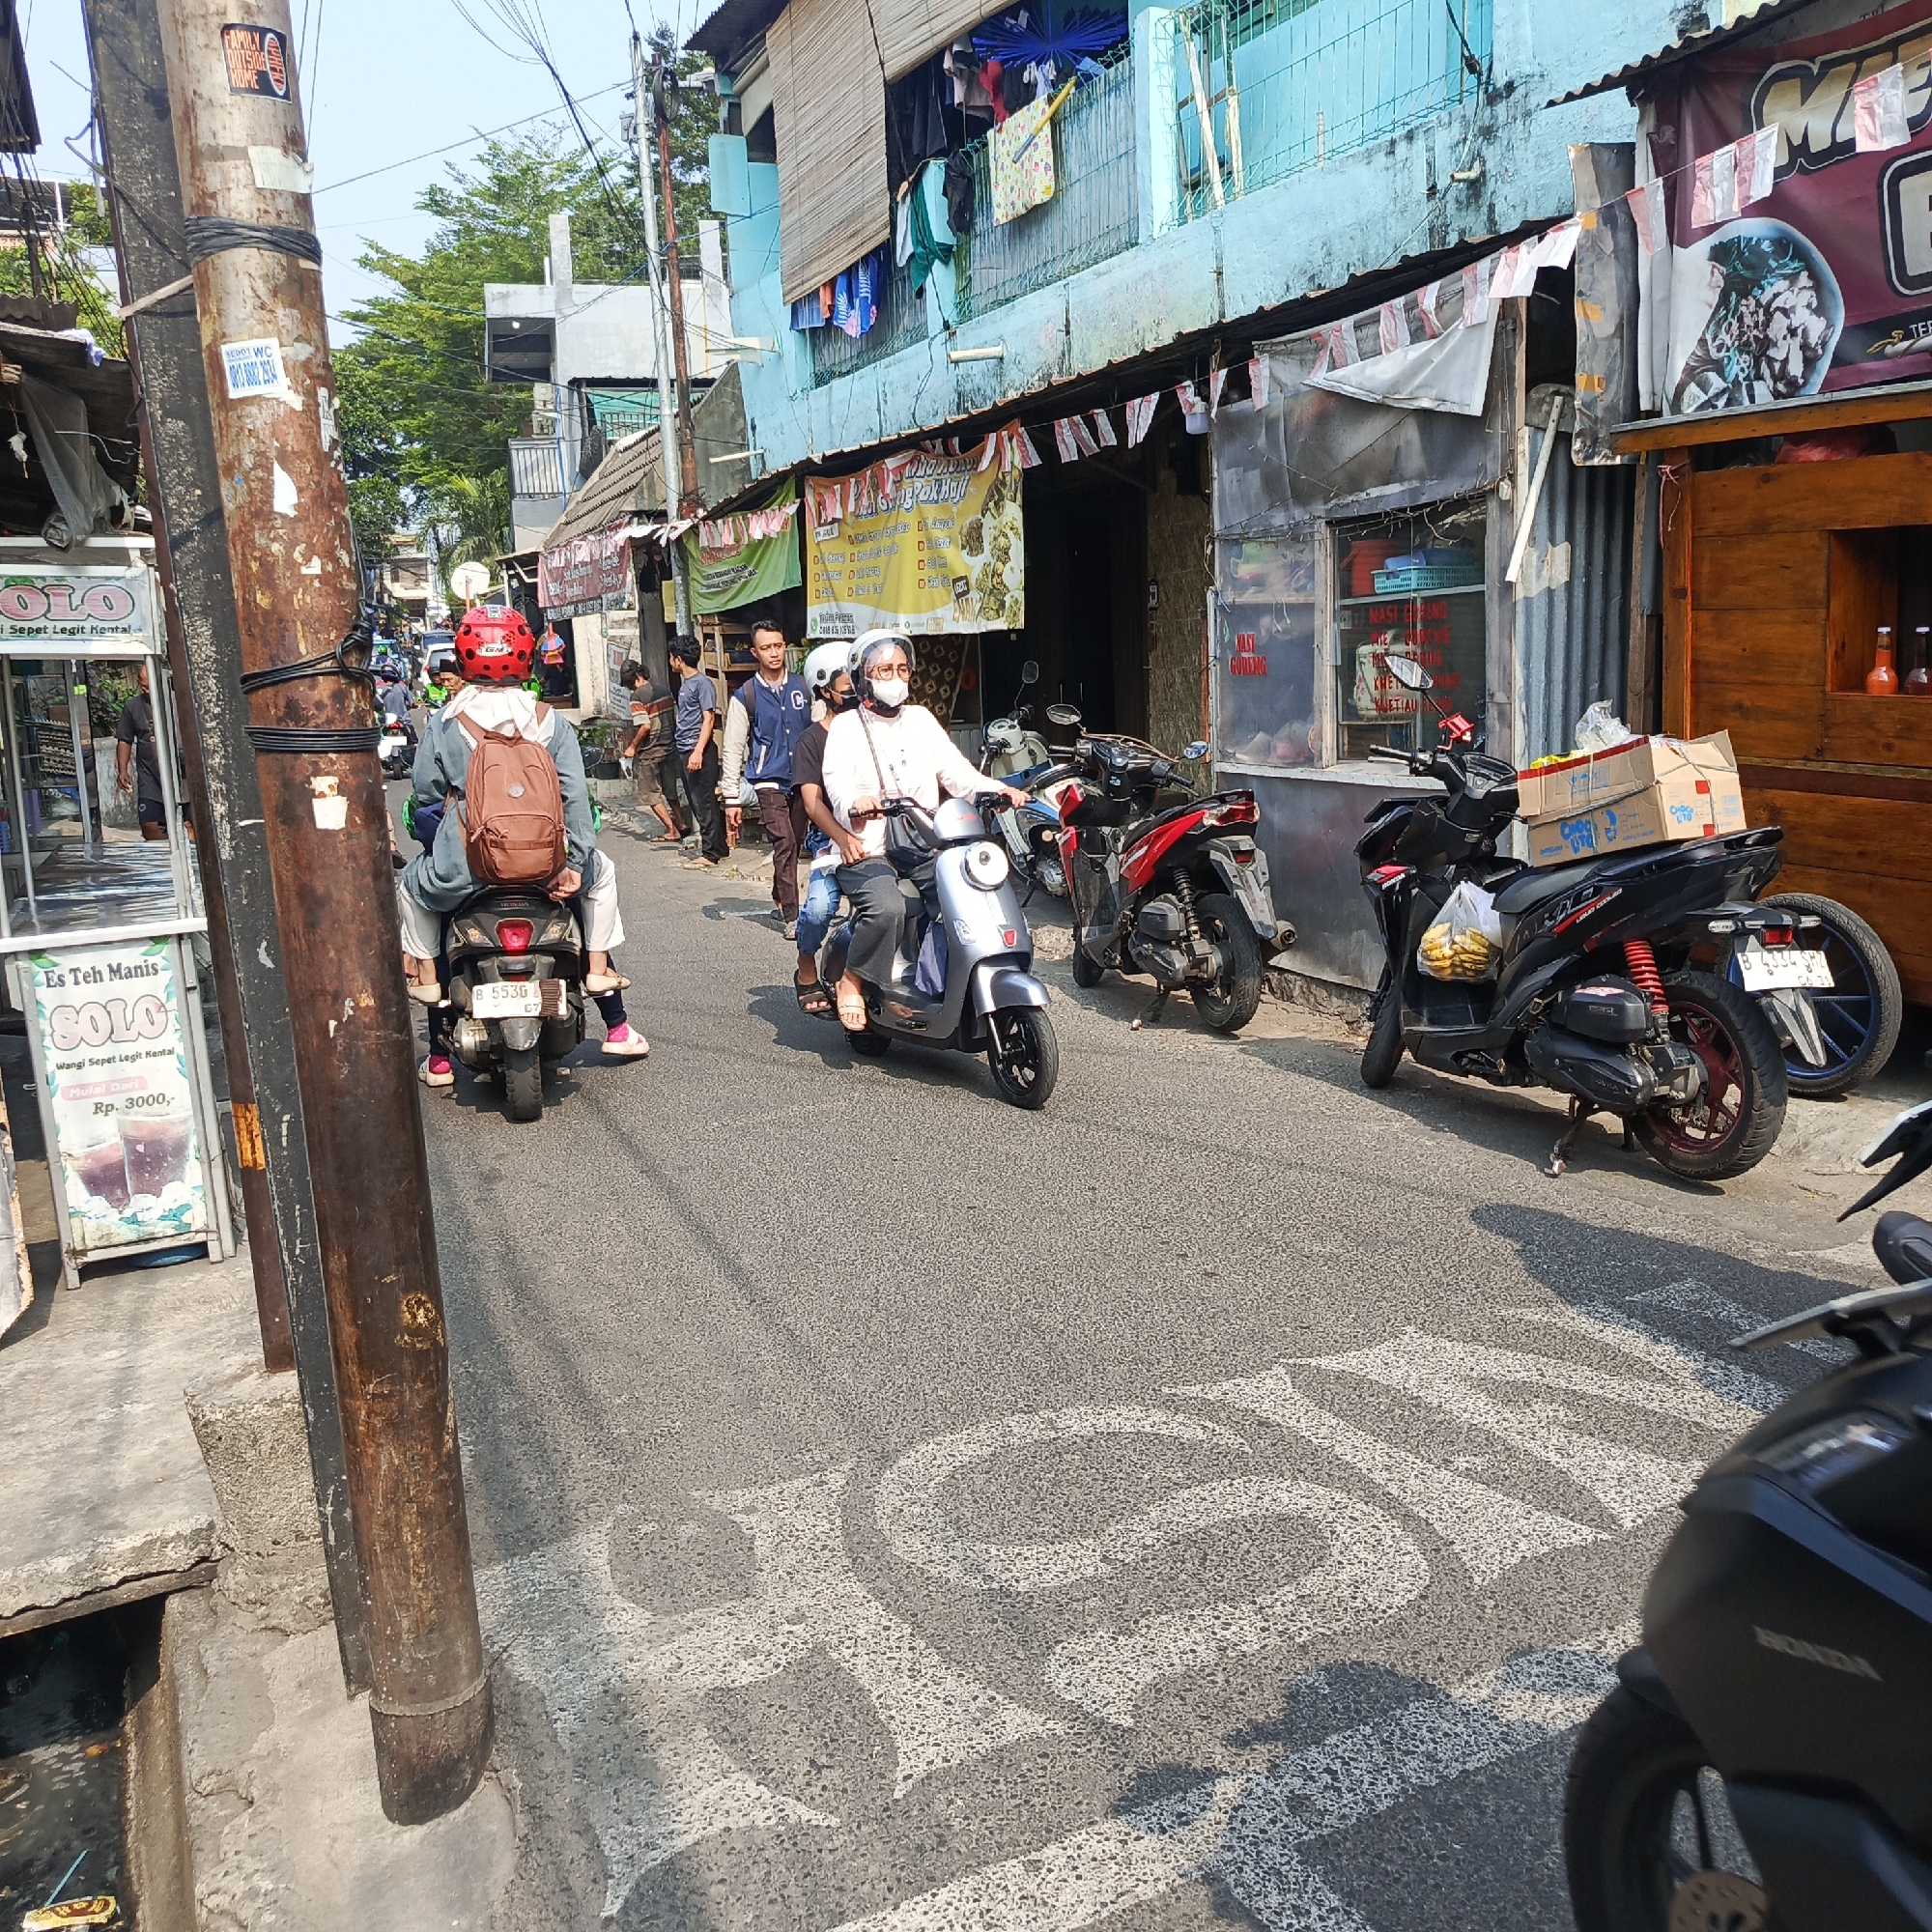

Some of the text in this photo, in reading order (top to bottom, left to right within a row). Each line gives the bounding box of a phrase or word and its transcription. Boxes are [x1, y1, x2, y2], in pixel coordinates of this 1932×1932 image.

[224, 29, 261, 51] FAMILY
[227, 49, 267, 71] OUTSIDE
[229, 69, 260, 89] HOME
[226, 348, 251, 359] SEDOT
[253, 346, 273, 358] WC
[1369, 605, 1399, 625] NASI
[9, 624, 49, 637] Sepet
[52, 624, 89, 637] Legit
[1235, 633, 1256, 653] NASI
[1229, 656, 1268, 676] GORENG
[1381, 872, 1406, 891] HONDA
[1741, 952, 1752, 970] B
[43, 959, 159, 988] Es Teh Manis
[476, 988, 484, 1001] B
[50, 994, 168, 1052] SOLO
[56, 1046, 175, 1071] Wangi Sepet Legit Kental
[70, 1079, 139, 1098] Mulai Dari
[93, 1093, 176, 1117] Rp. 3000,-
